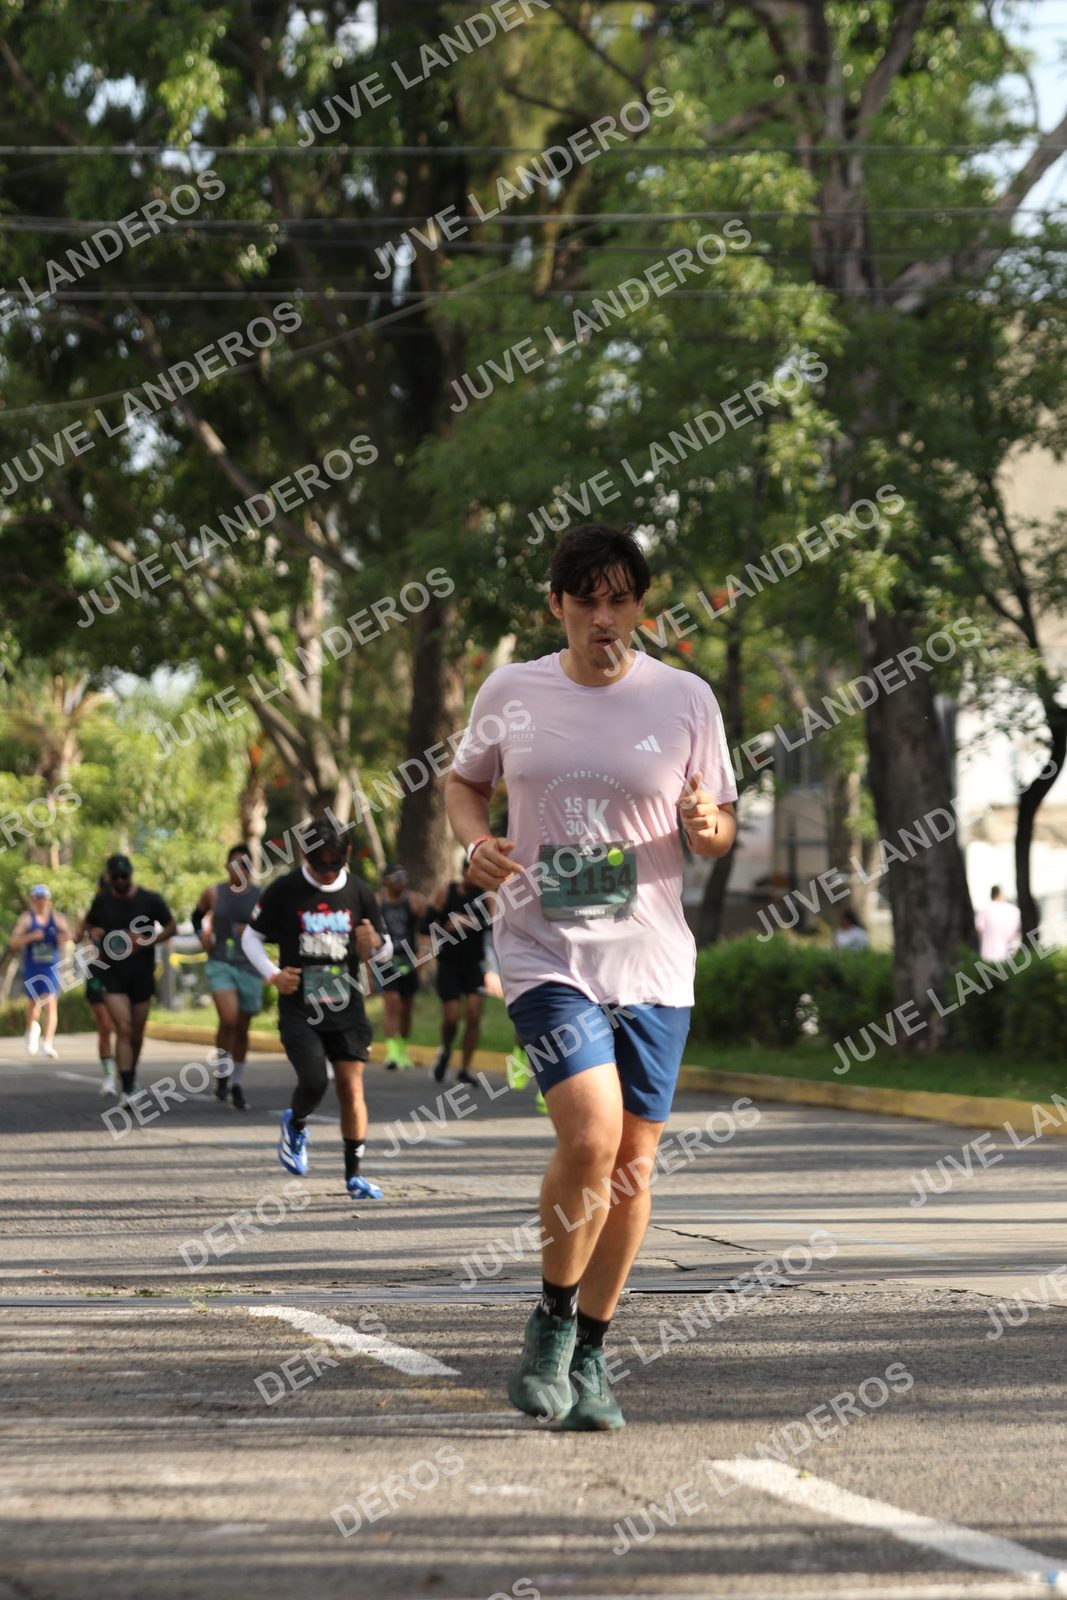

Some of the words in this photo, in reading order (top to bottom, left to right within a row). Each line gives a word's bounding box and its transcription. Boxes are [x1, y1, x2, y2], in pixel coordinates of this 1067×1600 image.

[564, 797, 583, 814] 15
[566, 820, 584, 836] 30
[587, 798, 611, 843] K
[567, 863, 633, 896] 1154
